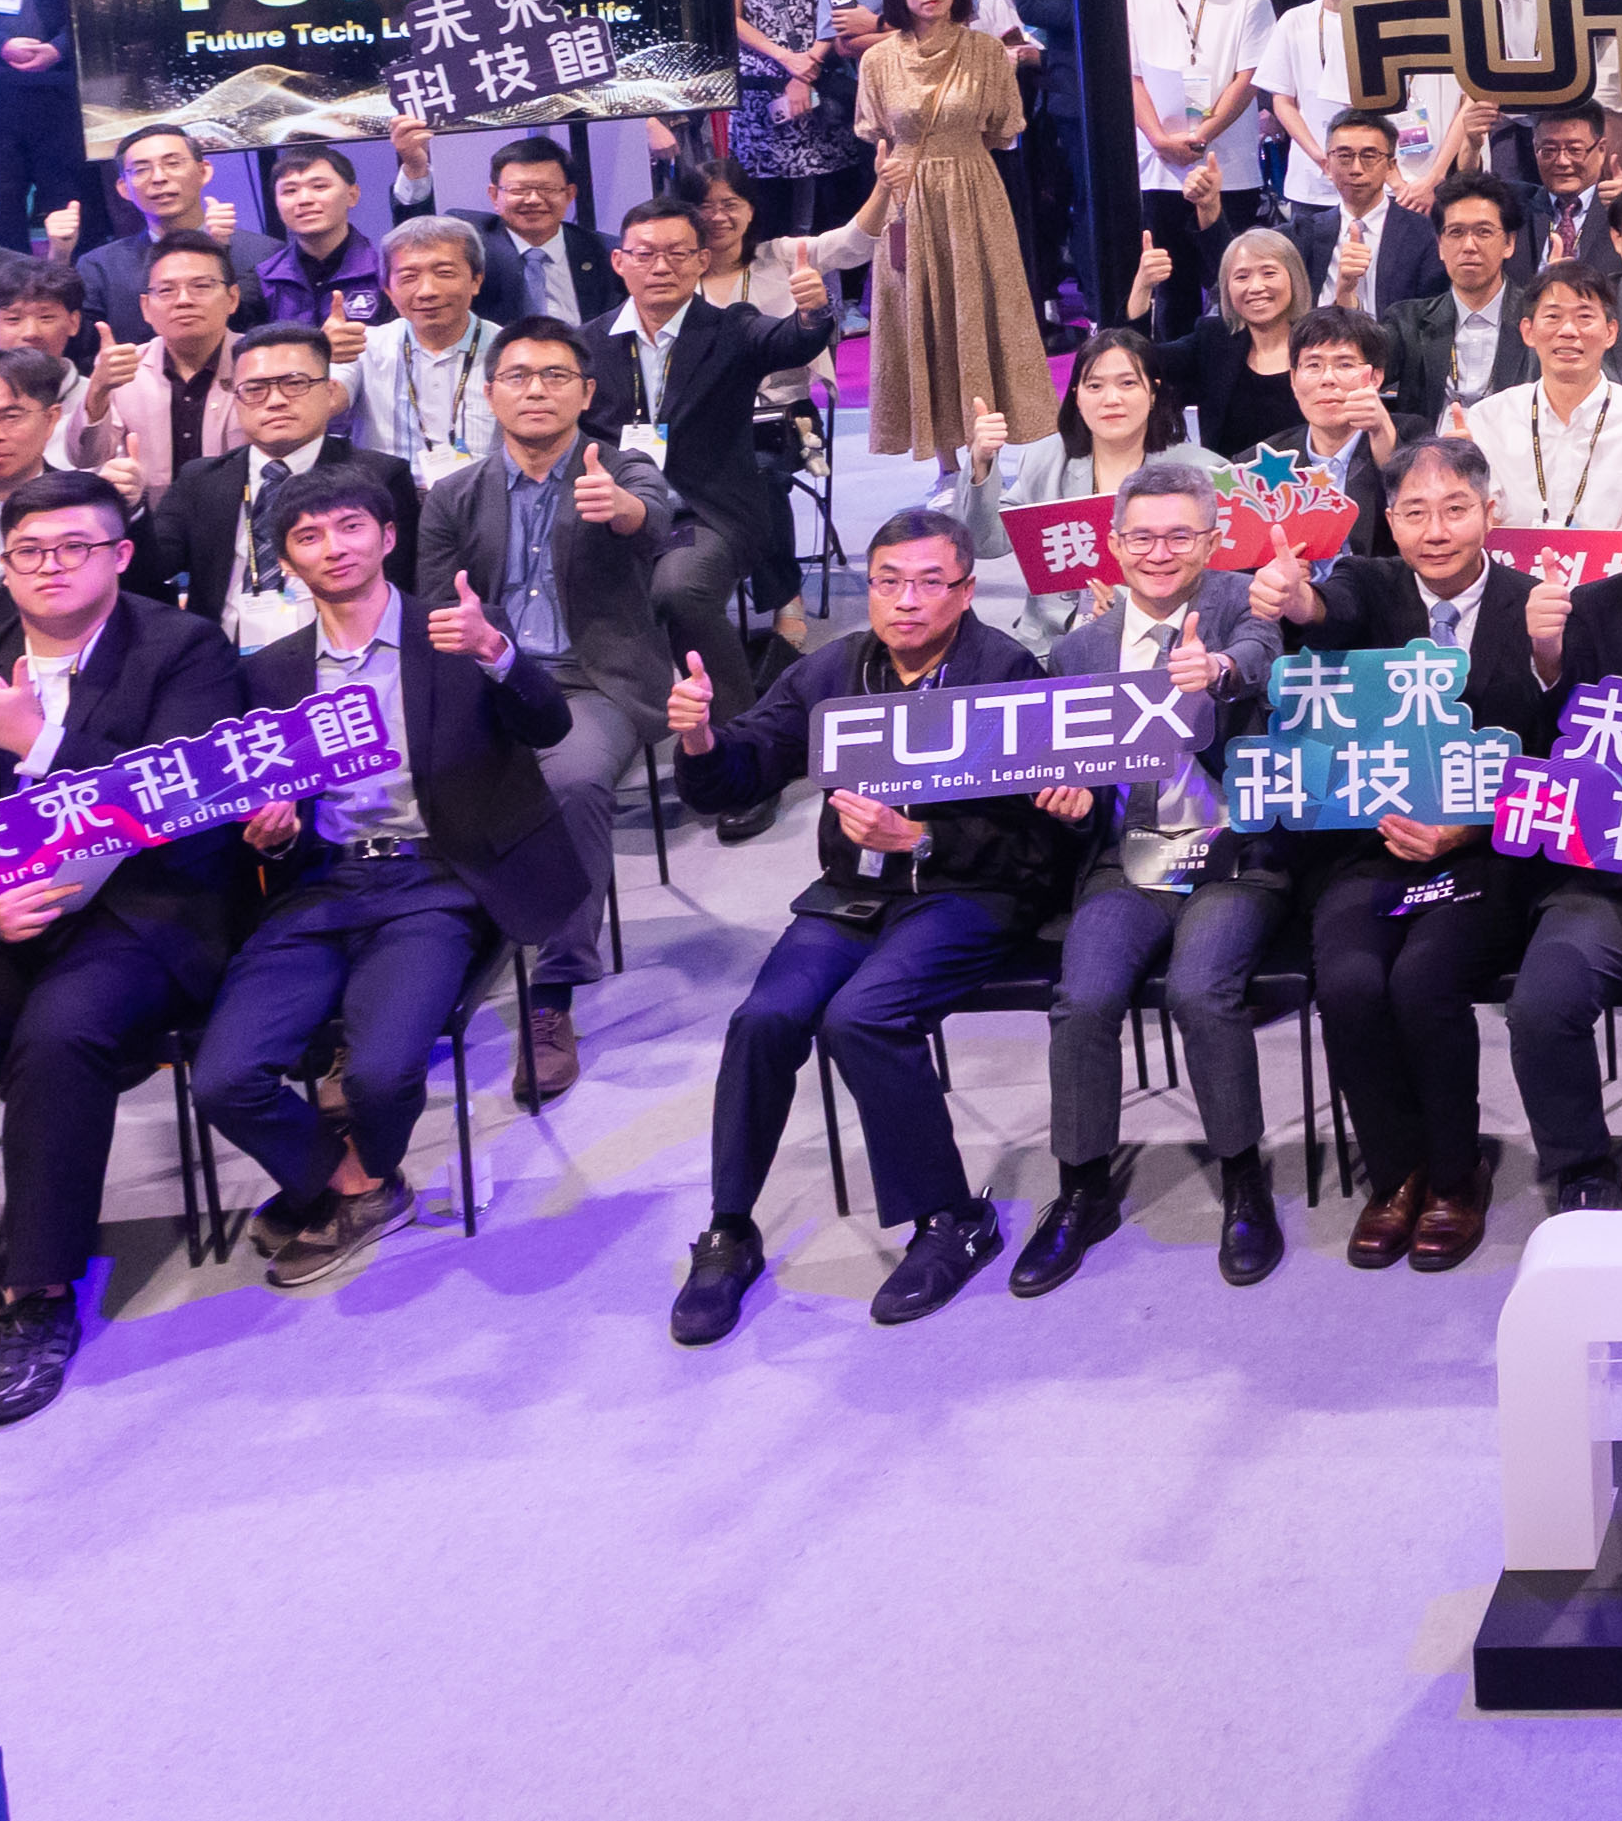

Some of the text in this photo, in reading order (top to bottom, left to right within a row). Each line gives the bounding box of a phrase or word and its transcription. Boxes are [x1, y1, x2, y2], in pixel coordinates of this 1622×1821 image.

[185, 25, 285, 54] Future
[291, 19, 375, 47] Tech,
[395, 23, 613, 122] 科技館
[821, 682, 1196, 774] FUTEX
[1278, 654, 1461, 733] 未來
[57, 834, 137, 869] Tech,
[143, 791, 252, 841] Leading
[260, 771, 324, 803] Your
[332, 749, 392, 783] Life.
[857, 752, 1167, 796] Future Tech, Leading Your Life.
[1234, 739, 1506, 823] 科技館
